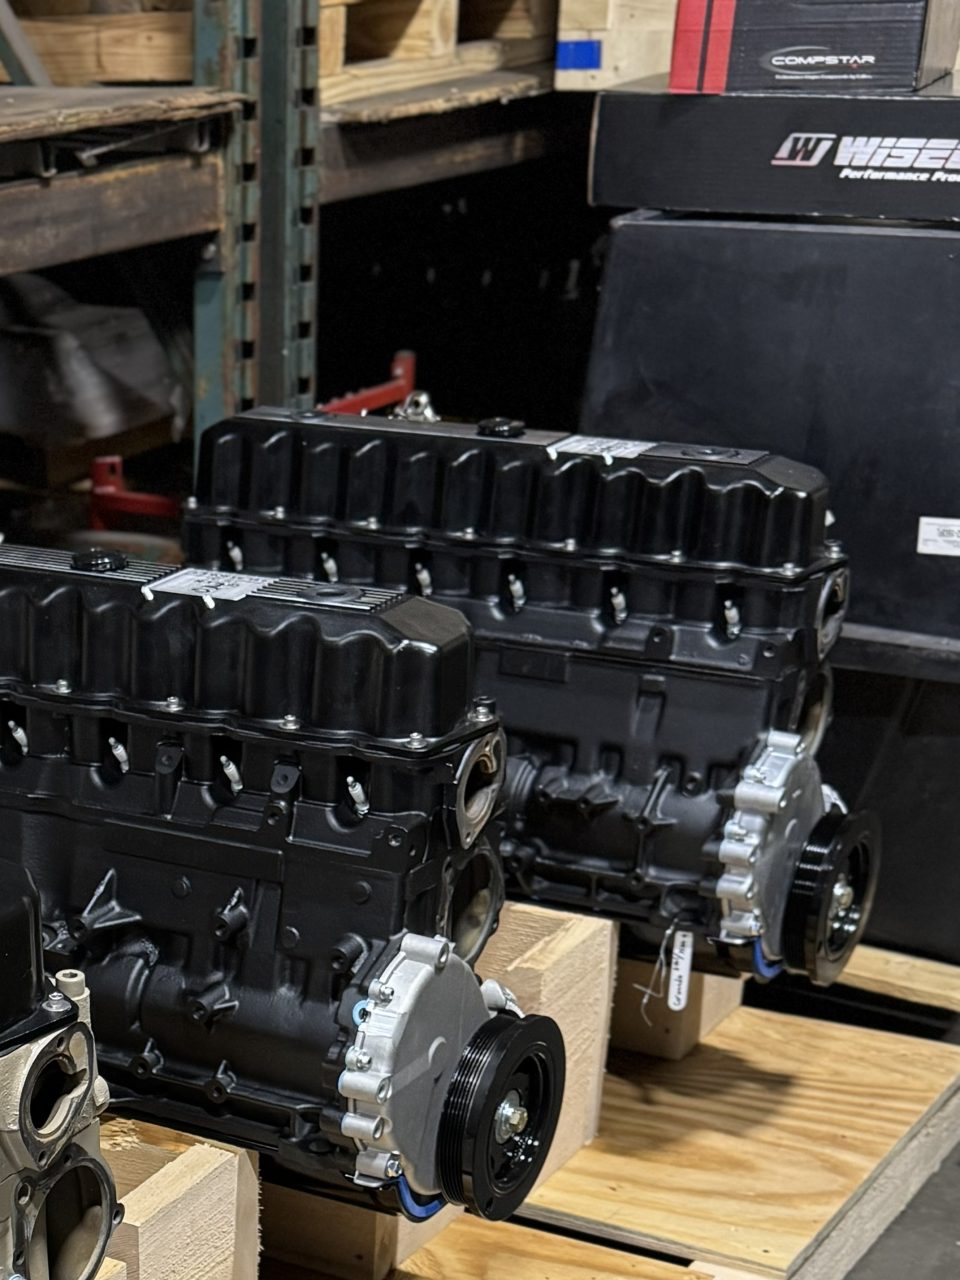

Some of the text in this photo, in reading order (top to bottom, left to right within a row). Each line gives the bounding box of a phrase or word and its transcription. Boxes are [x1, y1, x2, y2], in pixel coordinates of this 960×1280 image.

[771, 55, 875, 65] COMPSTAR
[833, 136, 960, 169] WISE
[839, 168, 930, 182] Performance
